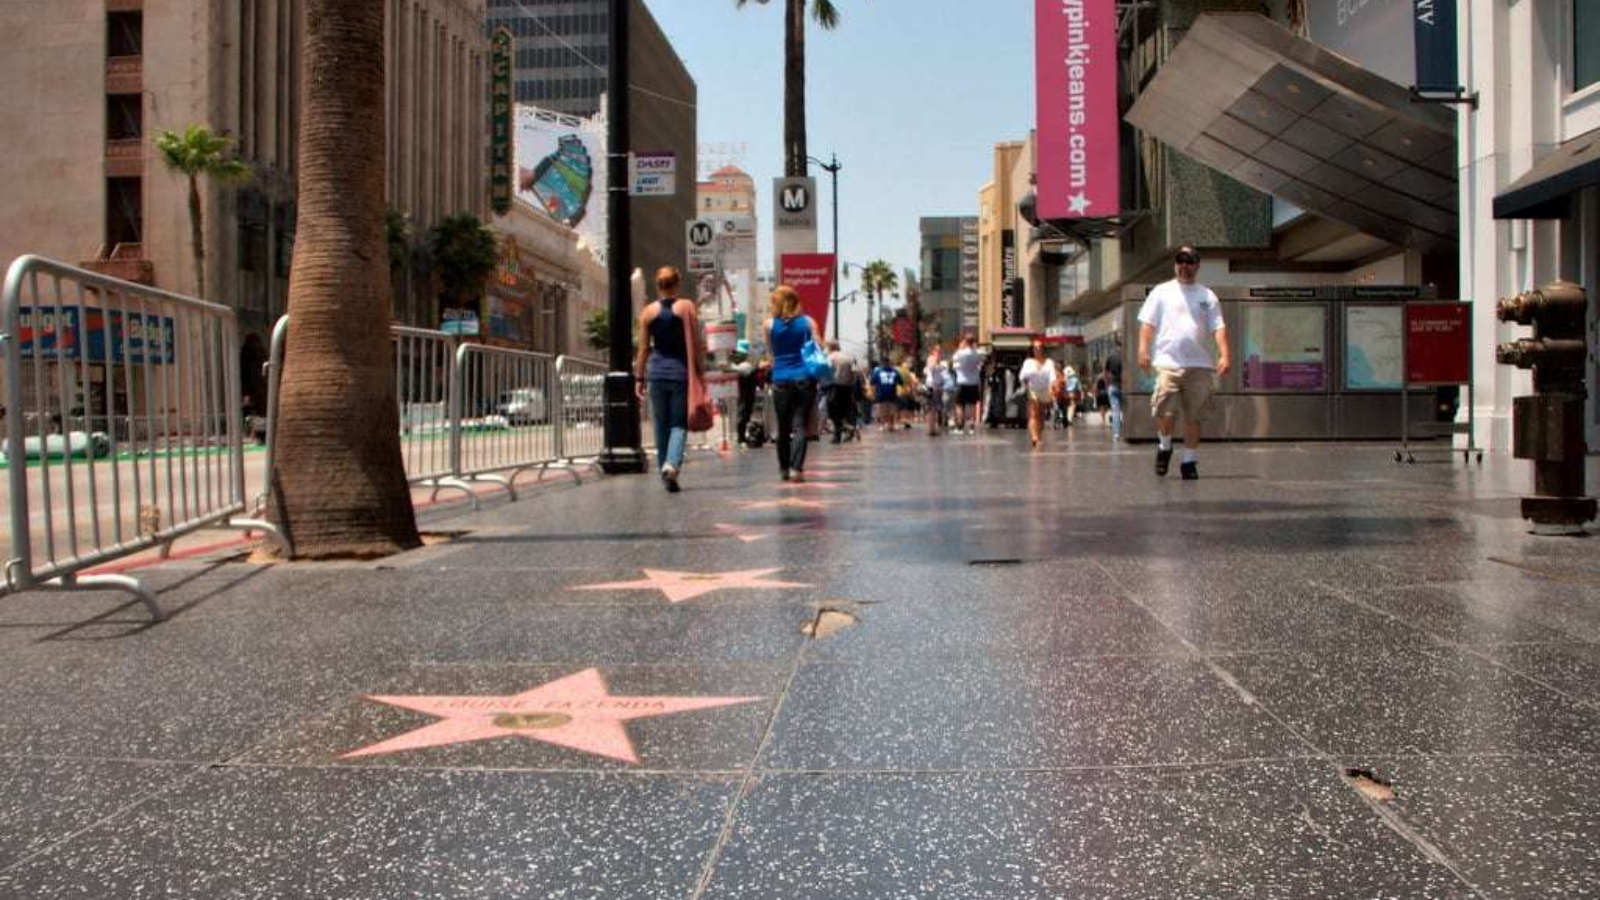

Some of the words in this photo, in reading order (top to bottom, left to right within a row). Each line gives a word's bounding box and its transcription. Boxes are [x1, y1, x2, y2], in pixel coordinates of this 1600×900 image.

[783, 188, 805, 209] M
[962, 222, 978, 328] MEGASTORE
[1002, 247, 1014, 291] Theatre
[433, 700, 525, 710] LOUISE
[544, 700, 665, 711] FAZENDA
